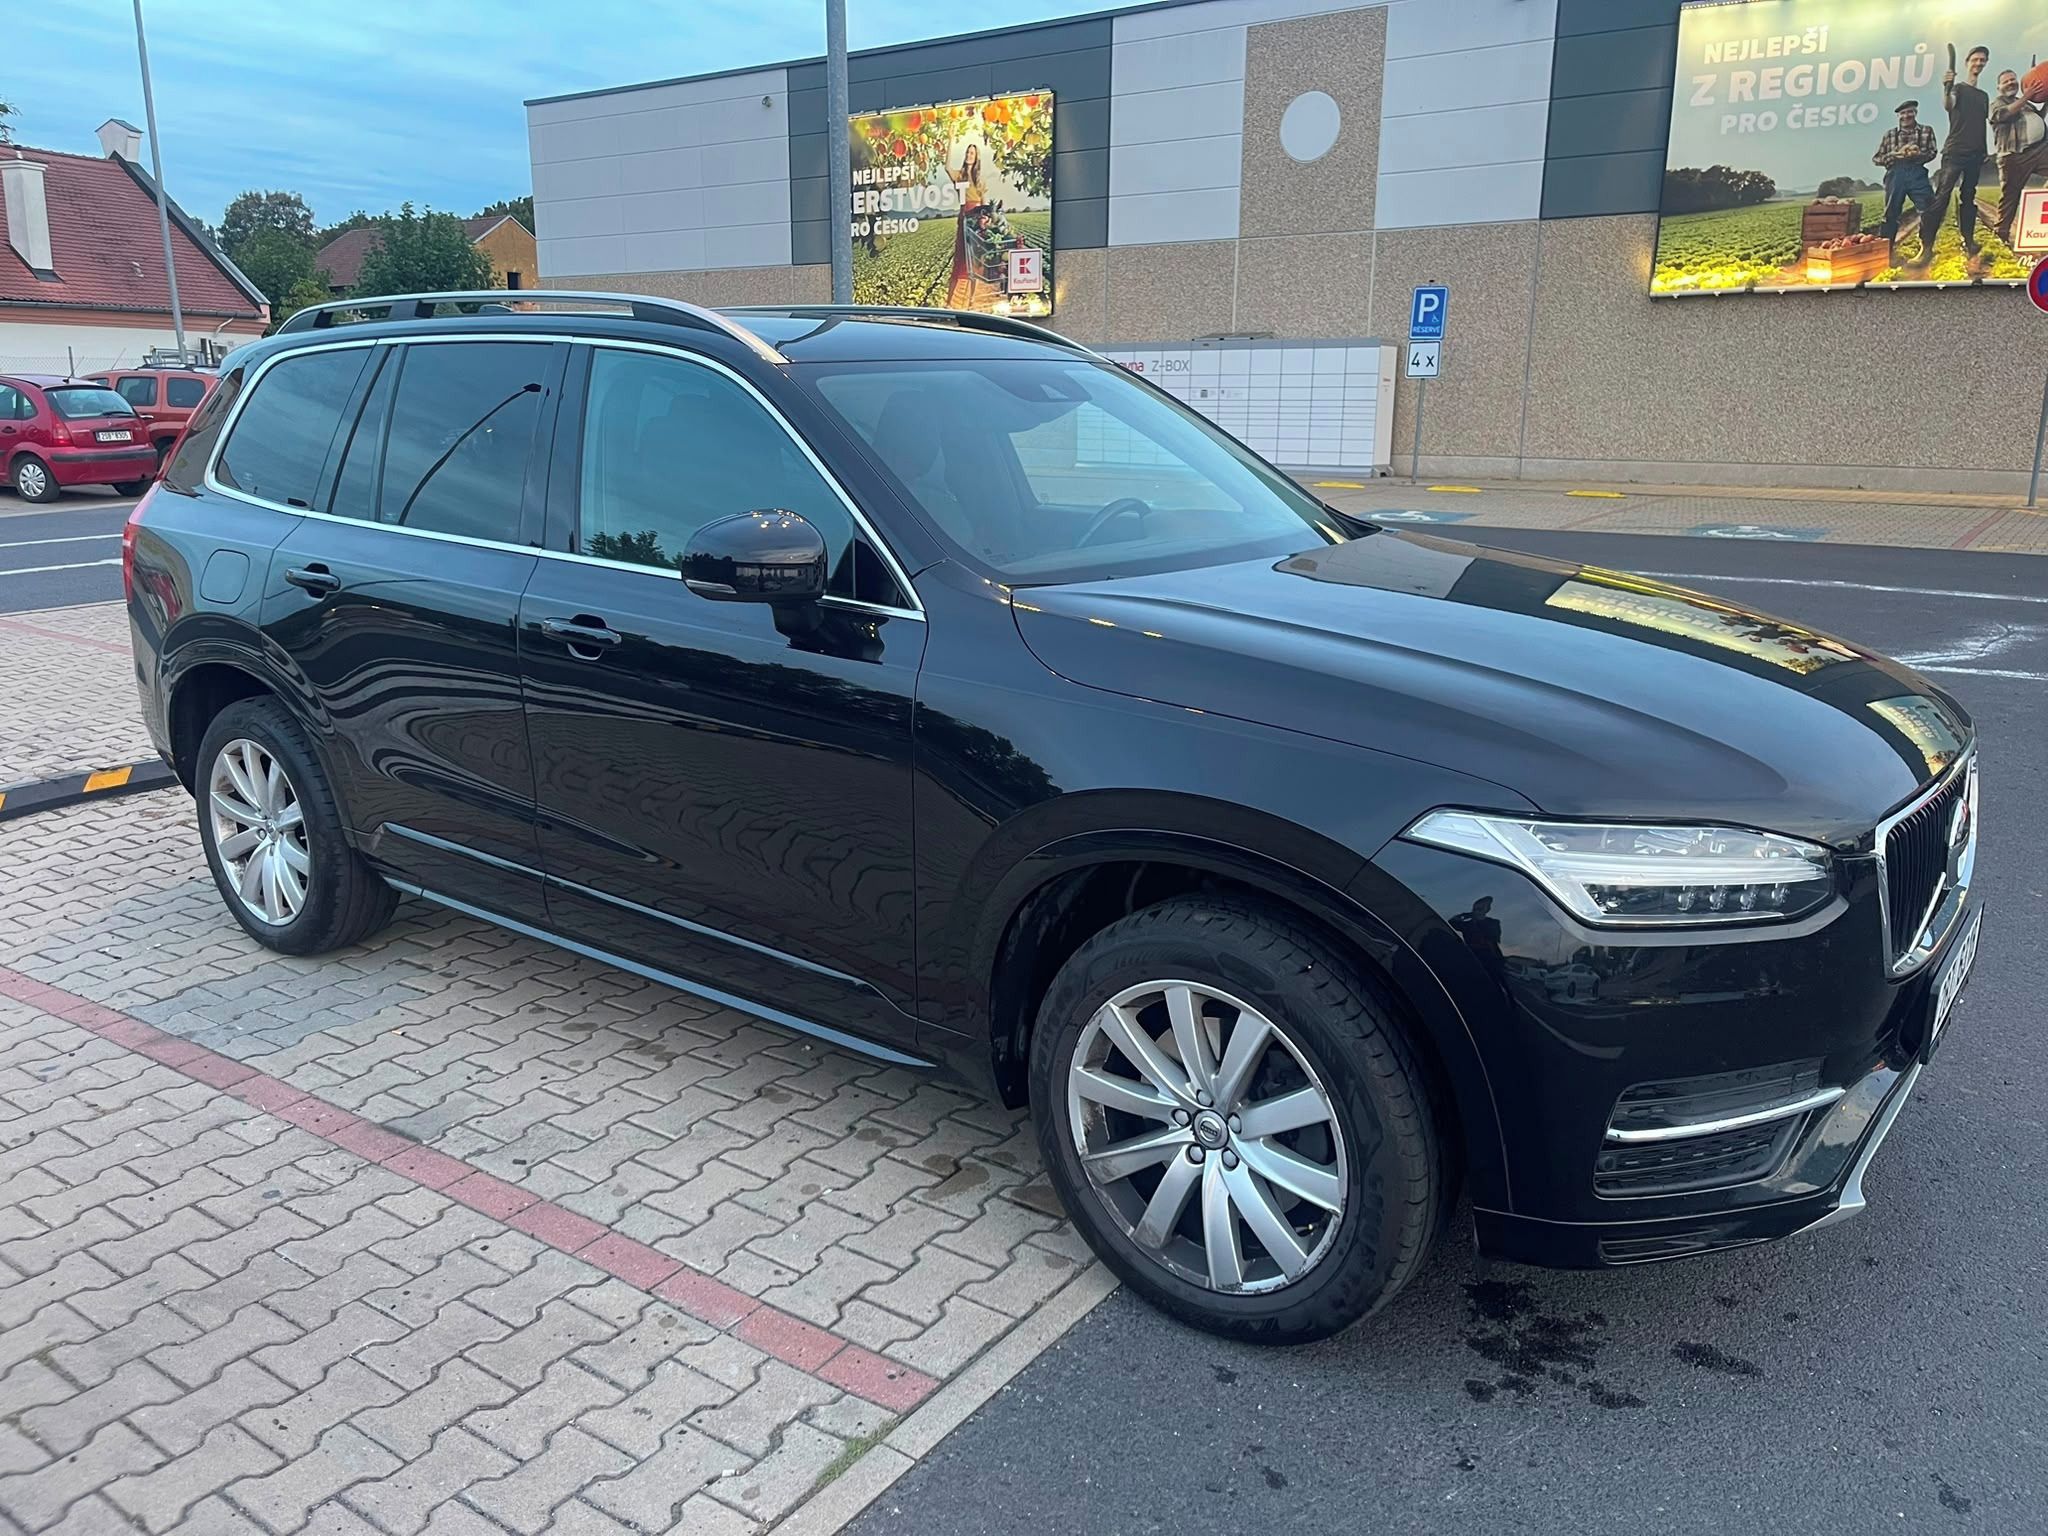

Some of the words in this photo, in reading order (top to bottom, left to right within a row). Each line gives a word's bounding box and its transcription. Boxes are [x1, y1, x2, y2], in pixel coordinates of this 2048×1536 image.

[1704, 26, 1829, 65] NEJLEPŠÍ
[1690, 74, 1717, 107] Z
[1728, 43, 1935, 103] REGIONŮ
[1720, 110, 1779, 136] PRO
[1786, 103, 1880, 130] ČESKO
[853, 161, 916, 186] NEJLEPŠÍ
[849, 181, 970, 214] ERSTVOST
[851, 222, 871, 238] RO
[873, 216, 920, 236] ČESKO
[1418, 293, 1440, 324] P
[1151, 360, 1190, 372] Z-BOX
[1411, 352, 1421, 368] 4
